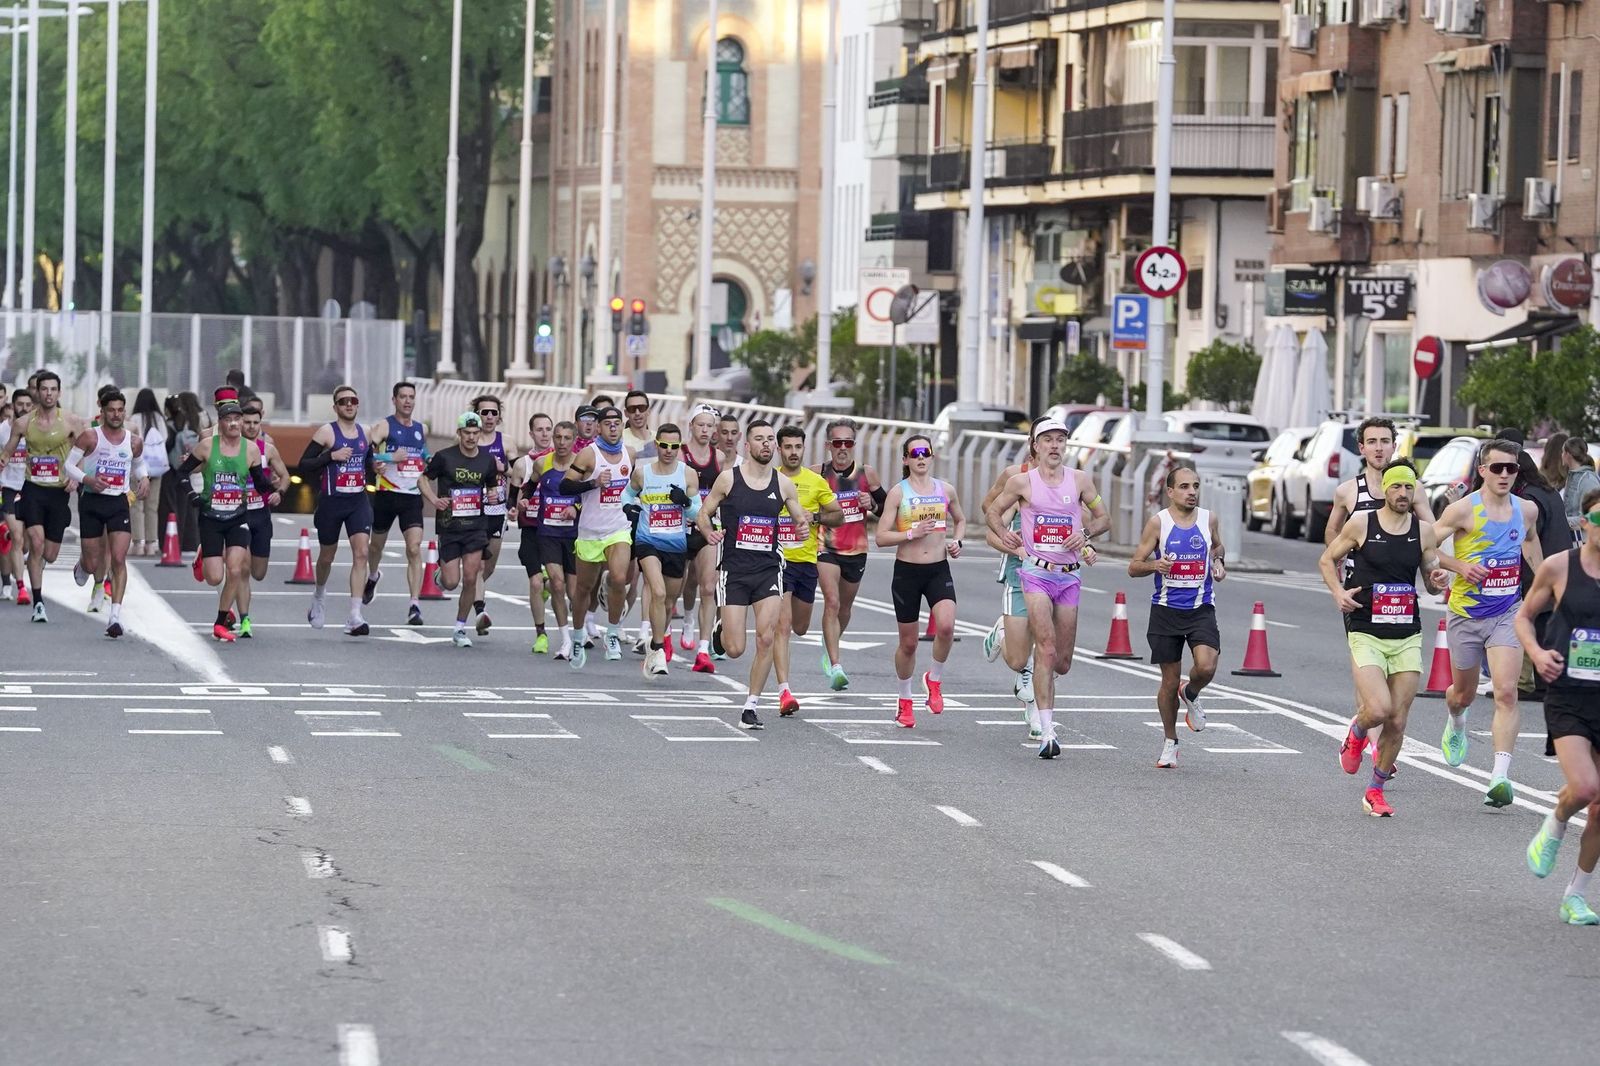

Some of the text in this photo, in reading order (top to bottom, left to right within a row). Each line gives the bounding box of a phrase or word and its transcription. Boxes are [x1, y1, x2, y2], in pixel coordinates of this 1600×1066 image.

[1348, 280, 1404, 295] TINTE
[1362, 294, 1397, 319] 5€
[1118, 300, 1140, 329] P
[651, 519, 667, 527] JOSE
[741, 533, 770, 543] THOMAS
[1041, 534, 1064, 543] CHRIS
[1485, 576, 1518, 587] ANTHONY
[1381, 605, 1407, 614] GORDY
